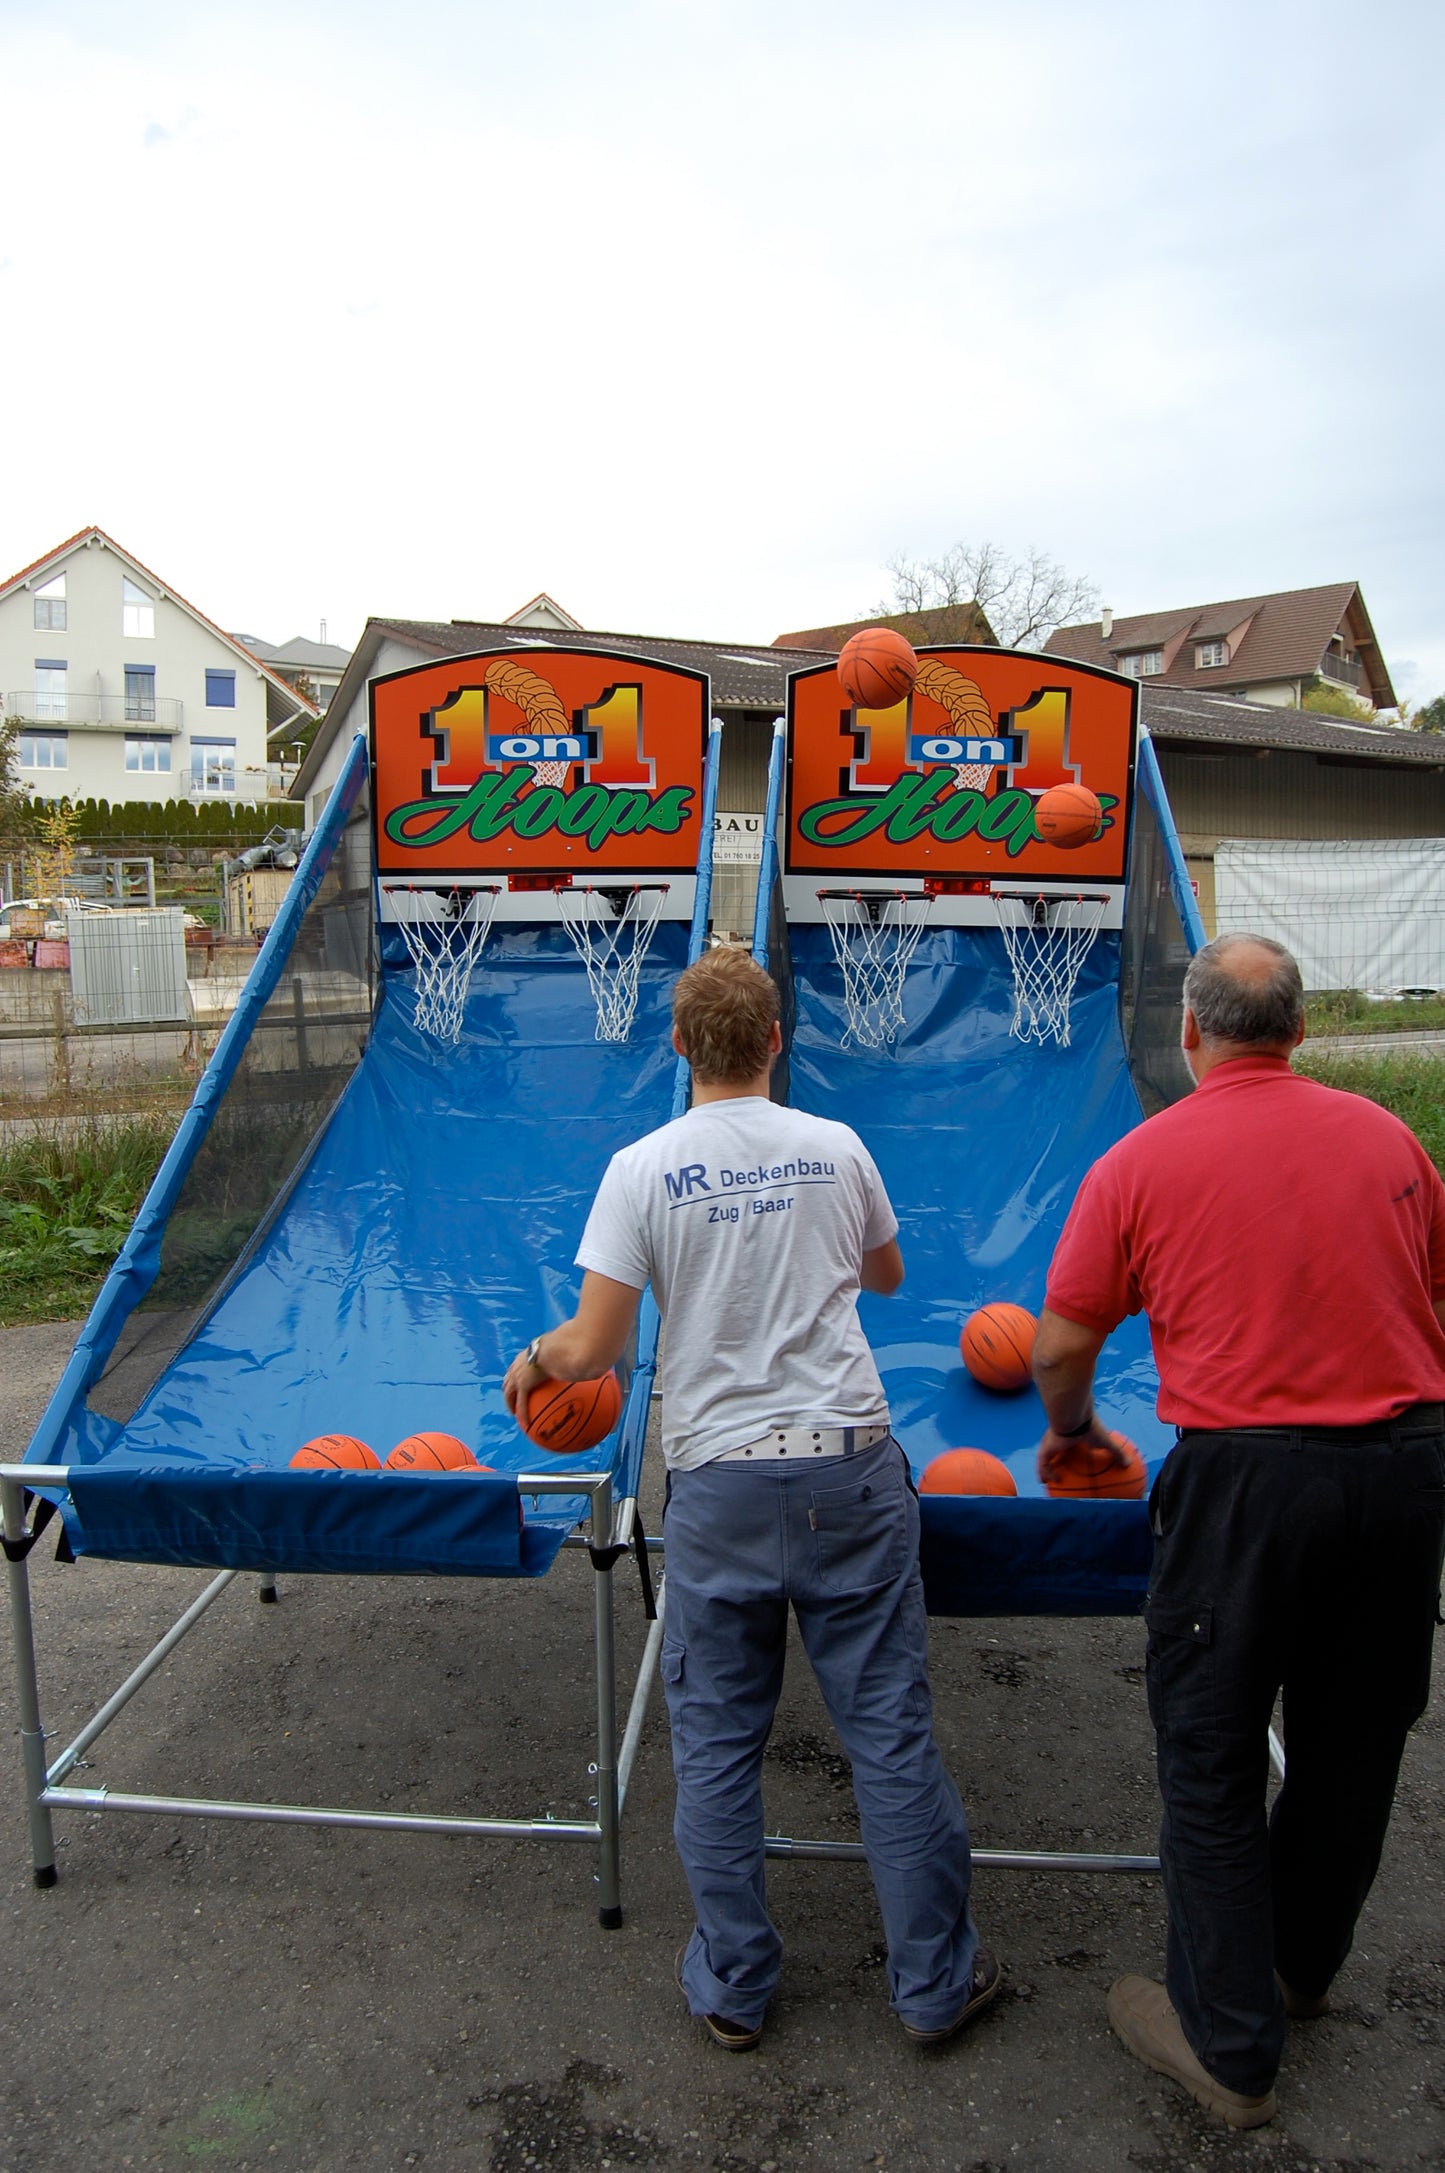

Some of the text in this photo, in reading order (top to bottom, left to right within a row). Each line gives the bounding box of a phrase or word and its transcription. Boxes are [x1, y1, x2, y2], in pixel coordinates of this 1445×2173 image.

[421, 683, 656, 796] 1 on 1
[840, 686, 1081, 796] 1 on 1
[384, 765, 695, 852] Hoops
[664, 1158, 835, 1201] MR Deckenbau
[708, 1205, 740, 1223] Zug
[752, 1197, 794, 1215] Baar
